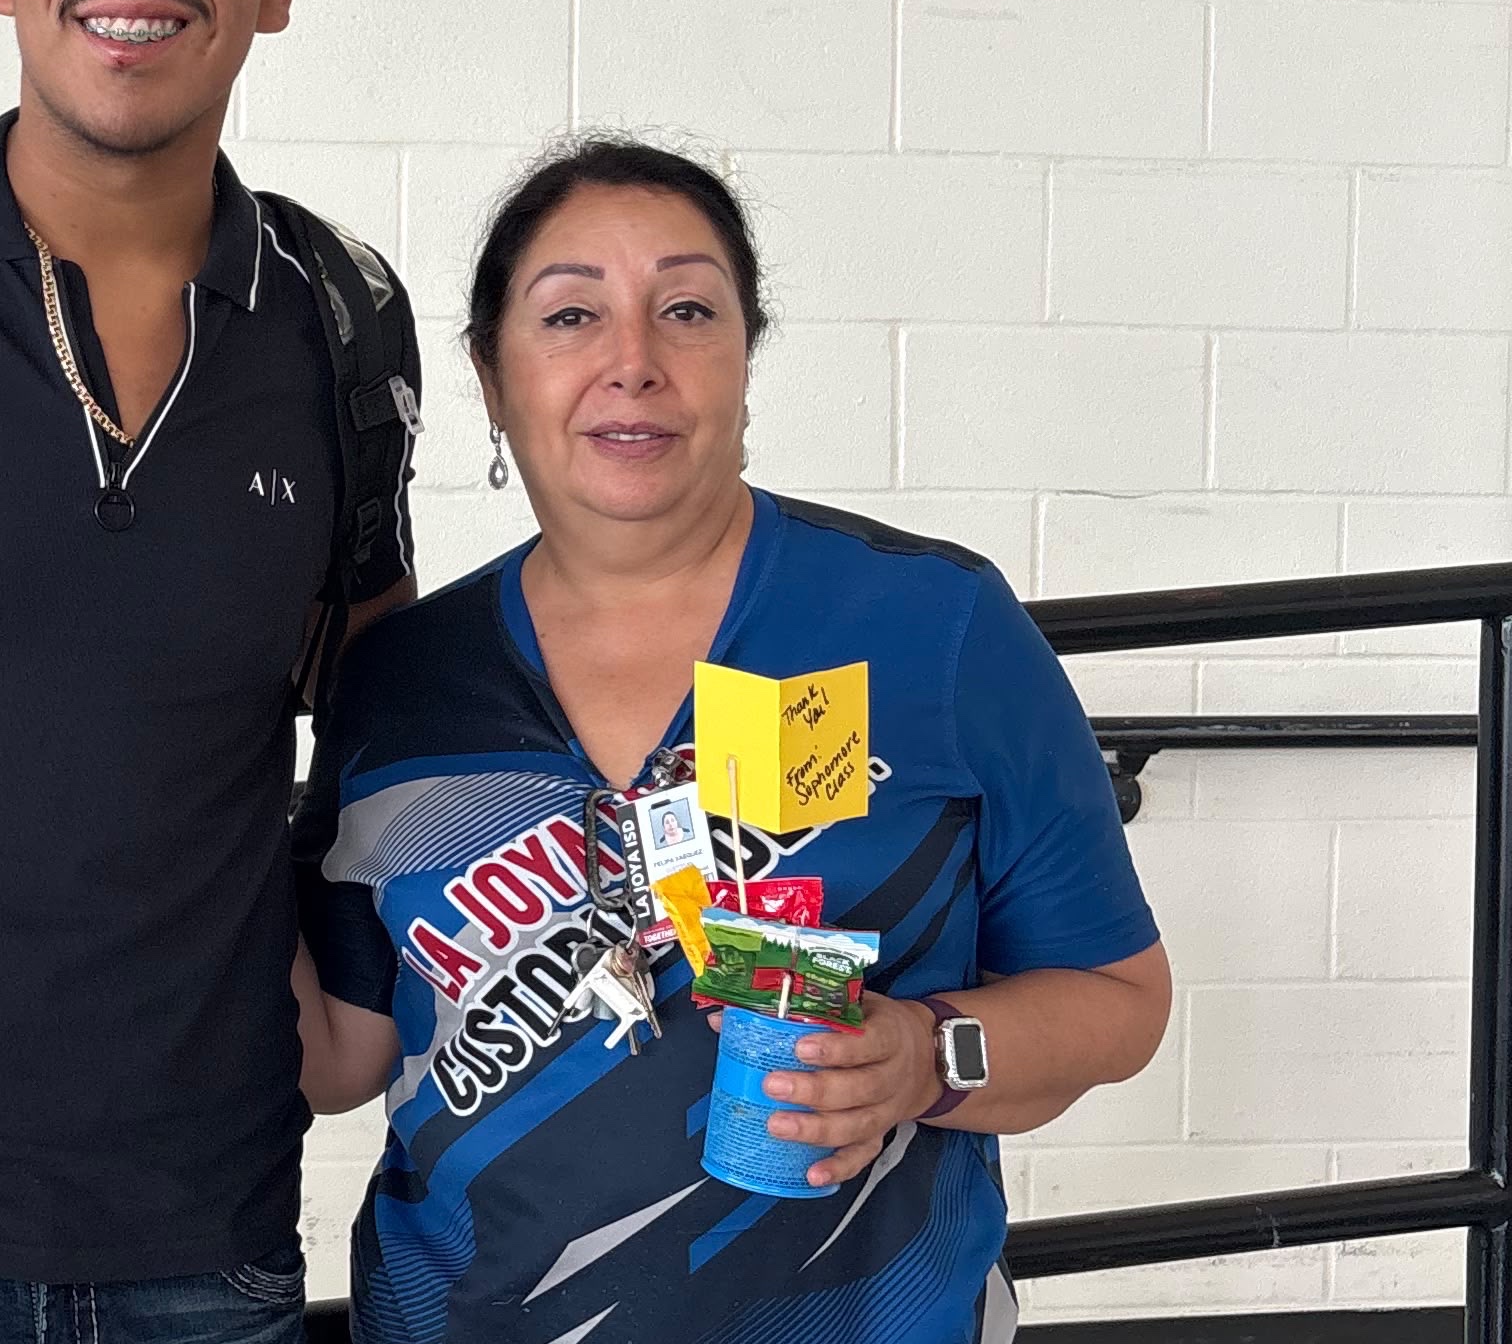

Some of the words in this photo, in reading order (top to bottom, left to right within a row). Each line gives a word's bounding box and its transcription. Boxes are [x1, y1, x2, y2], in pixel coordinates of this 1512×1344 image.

[781, 683, 819, 726] Thank
[803, 687, 830, 731] You!
[786, 744, 823, 788] From:
[794, 730, 861, 806] Sophomore
[825, 762, 855, 802] Class
[621, 819, 639, 848] ISD
[626, 848, 651, 894] JOYA
[403, 920, 483, 1003] LA
[448, 819, 625, 949] JOYA
[635, 894, 651, 919] LA
